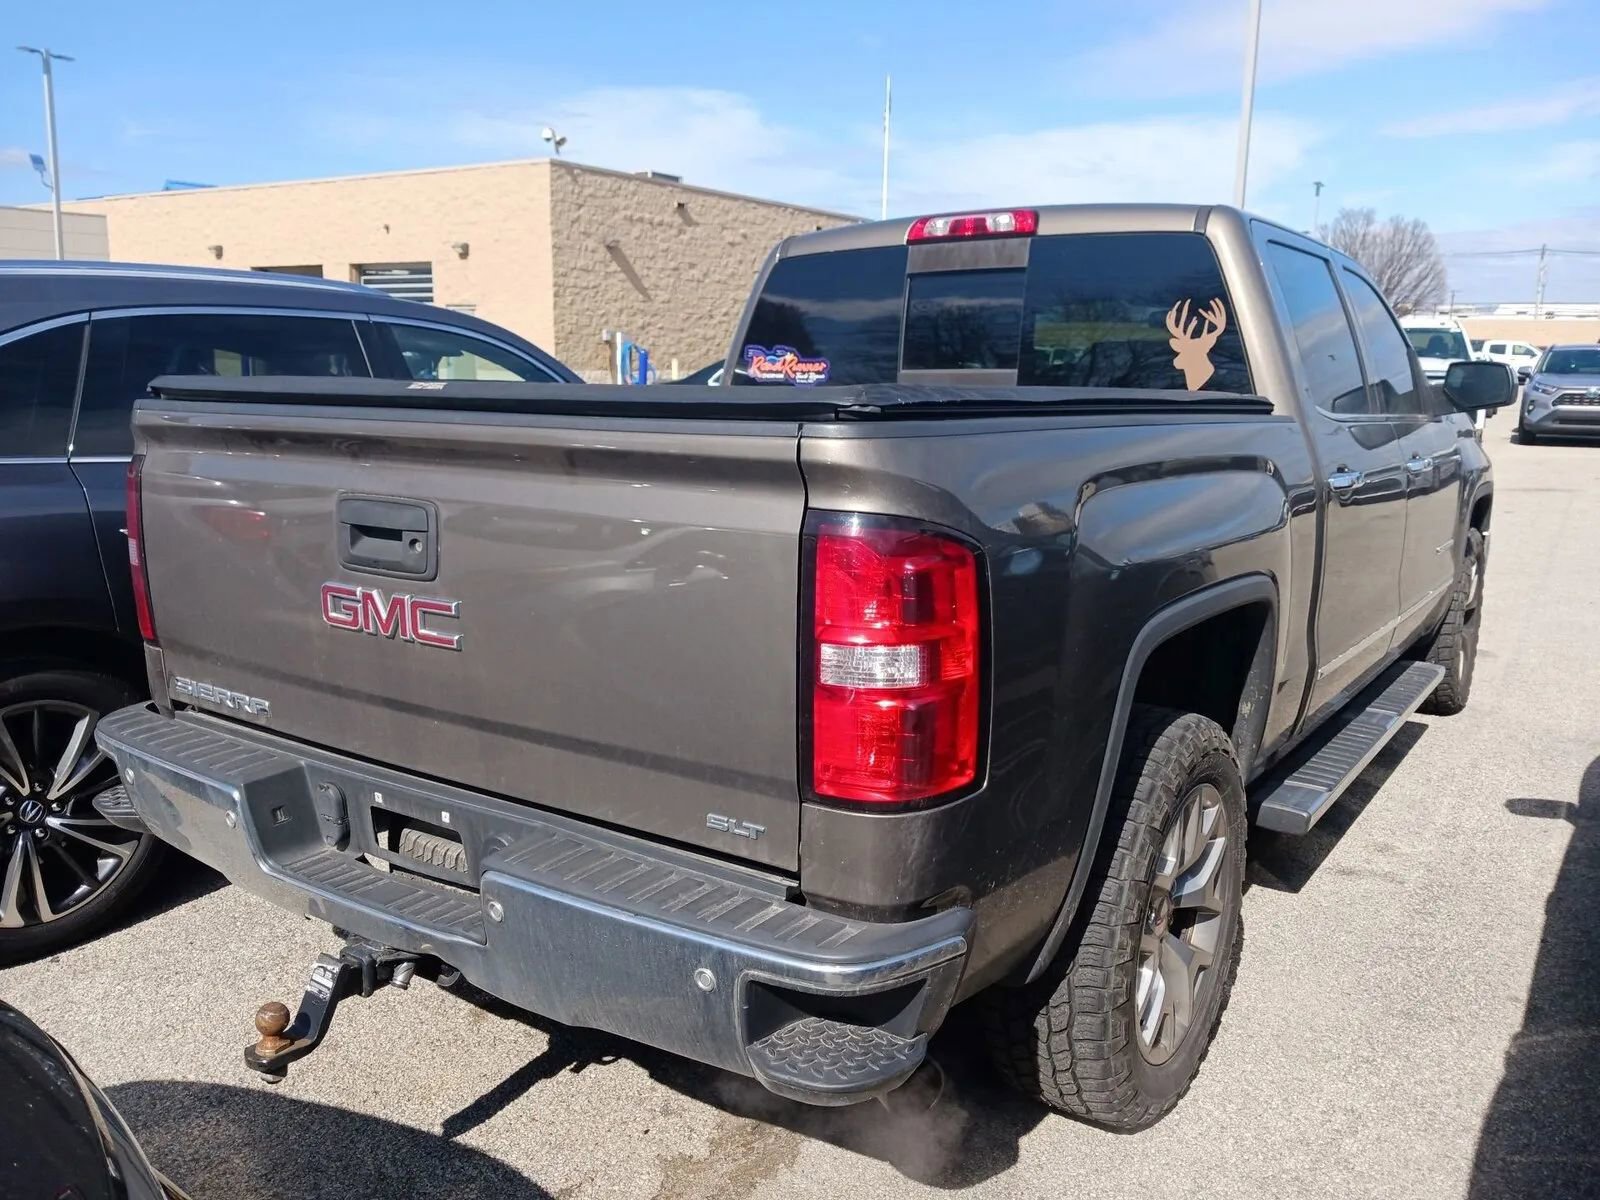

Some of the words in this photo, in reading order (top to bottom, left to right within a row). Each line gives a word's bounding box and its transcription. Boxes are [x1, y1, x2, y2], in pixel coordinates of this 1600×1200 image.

[321, 581, 464, 651] GMC
[175, 676, 272, 718] SIERRA
[706, 813, 767, 840] SLT
